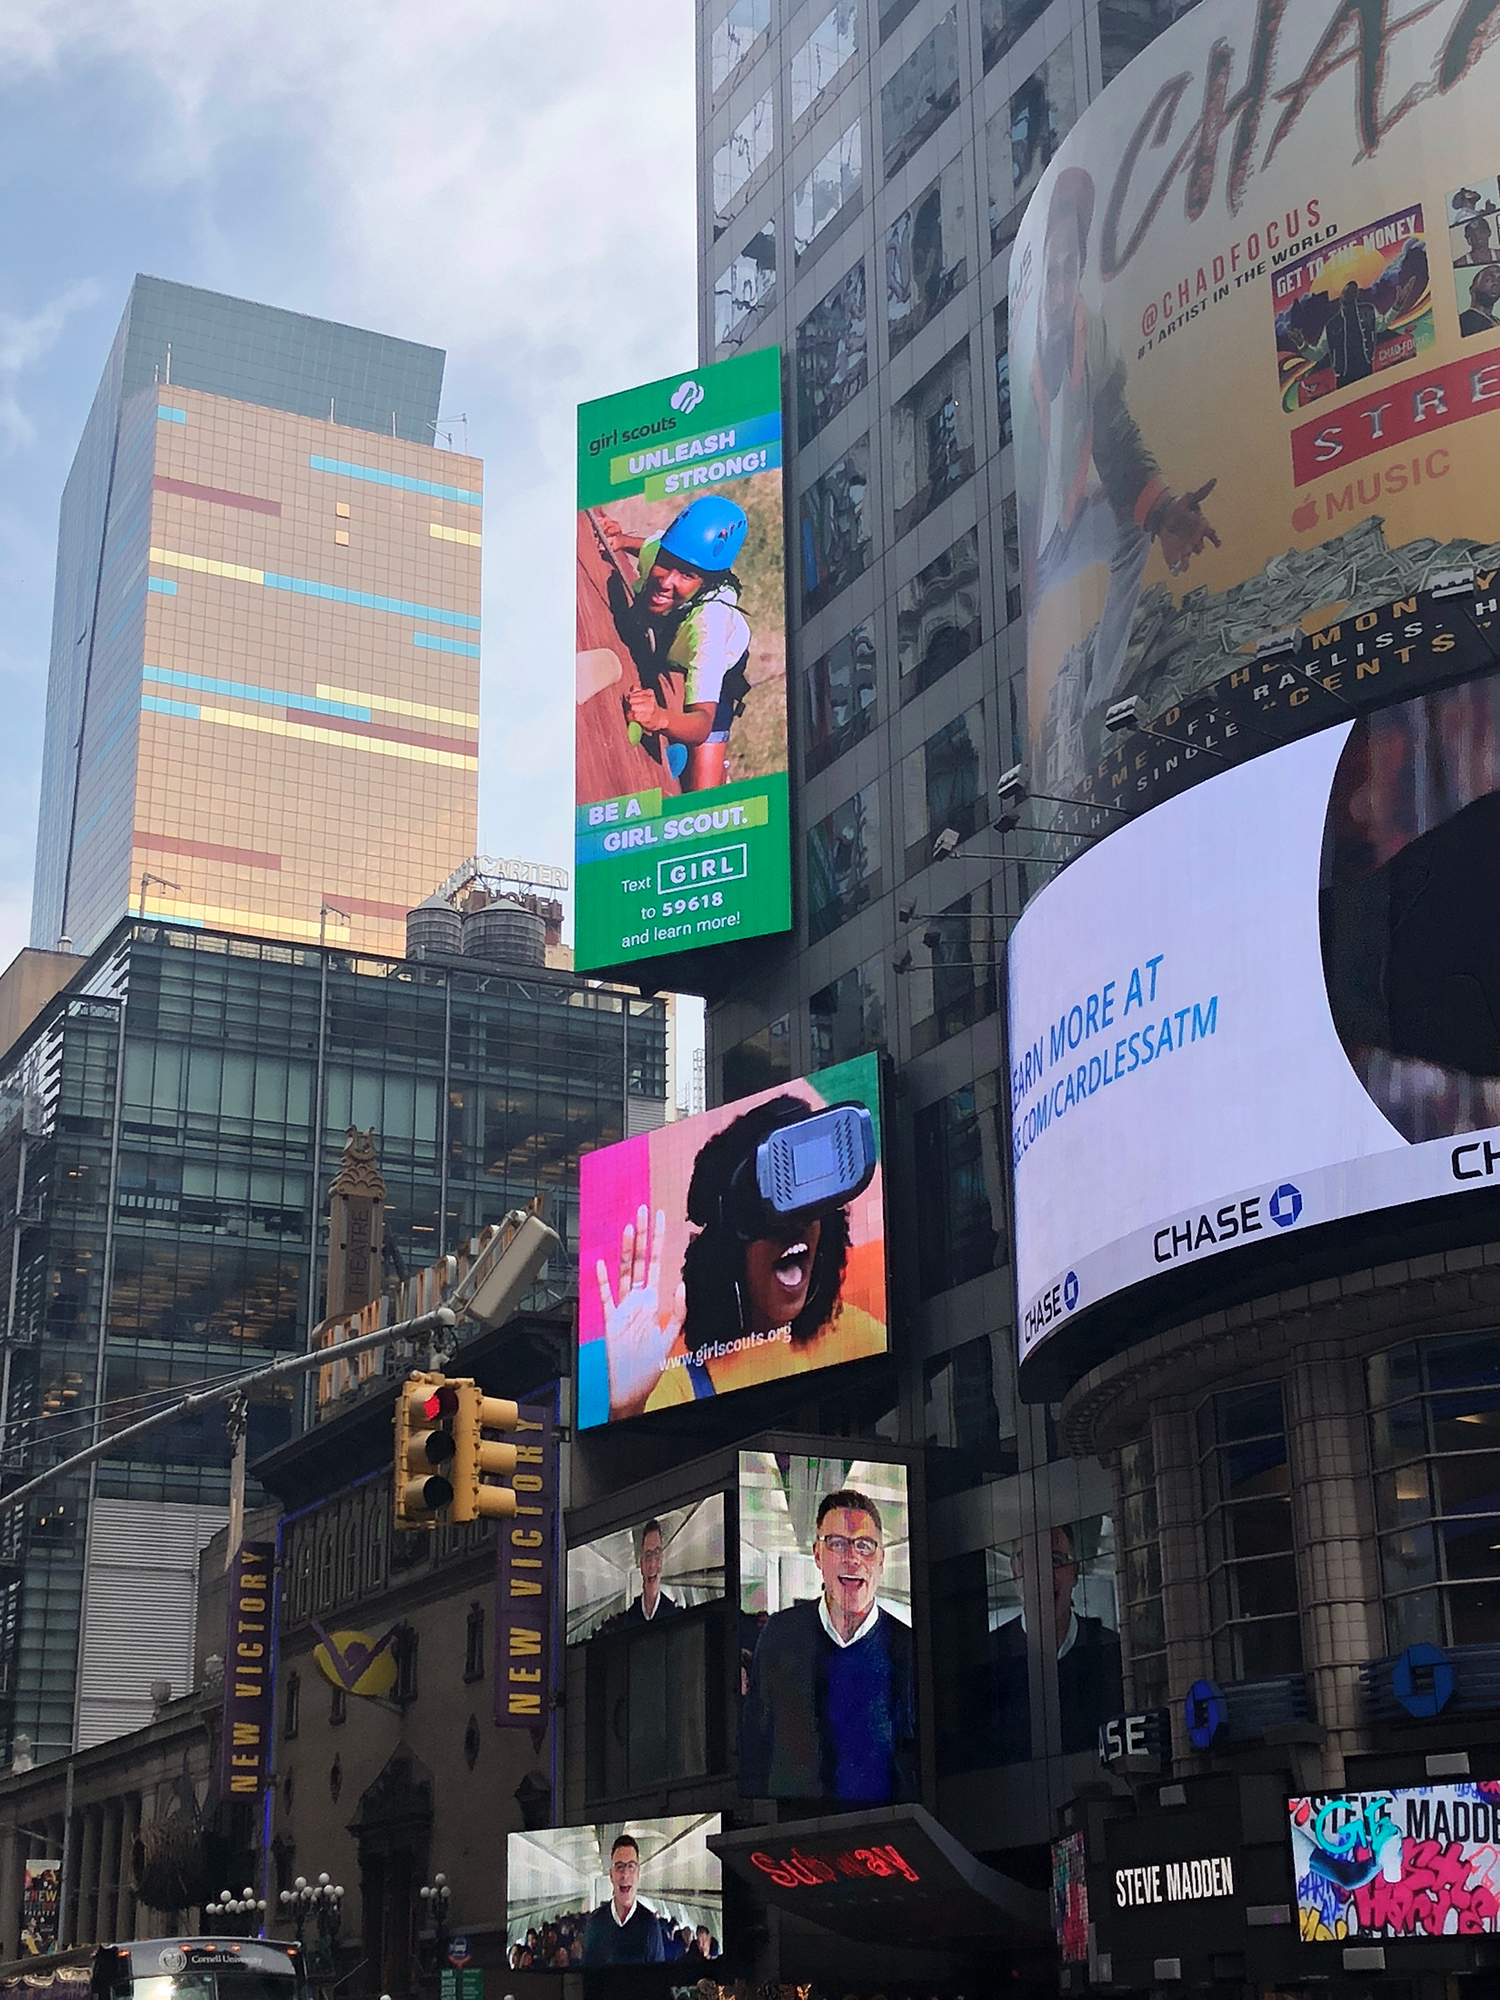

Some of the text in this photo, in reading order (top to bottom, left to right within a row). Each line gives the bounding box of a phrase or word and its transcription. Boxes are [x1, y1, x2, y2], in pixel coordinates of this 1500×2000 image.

[1141, 199, 1321, 337] @CHADFOCUS
[1276, 214, 1417, 298] GET TO THE MONEY
[1137, 224, 1338, 360] #1 ARTIST IN THE WORLD
[589, 417, 677, 456] girl scouts
[629, 430, 736, 475] UNLEASH
[664, 449, 767, 494] STRONG!
[1325, 449, 1450, 520] MUSIC
[1312, 570, 1498, 651] MONY
[1137, 722, 1239, 791] SINGLE
[588, 798, 642, 826] BE A
[603, 806, 748, 851] GIRL SCOUT.
[479, 855, 568, 890] CARTER
[621, 856, 733, 893] Text GIRL
[621, 911, 741, 948] and learn more!
[641, 892, 724, 920] to 59618
[1050, 981, 1115, 1067] MORE
[1123, 954, 1164, 1016] AT
[348, 1210, 369, 1294] THEATRE
[1153, 1196, 1264, 1263] CHASE
[1024, 1284, 1062, 1344] CHASE
[659, 1321, 792, 1371] www.girlscouts.org
[231, 1550, 267, 1793] NEW VICTORY
[508, 1627, 542, 1715] NEW
[1115, 1857, 1234, 1908] STEVE MADDEN
[191, 1954, 221, 1963] Cornell
